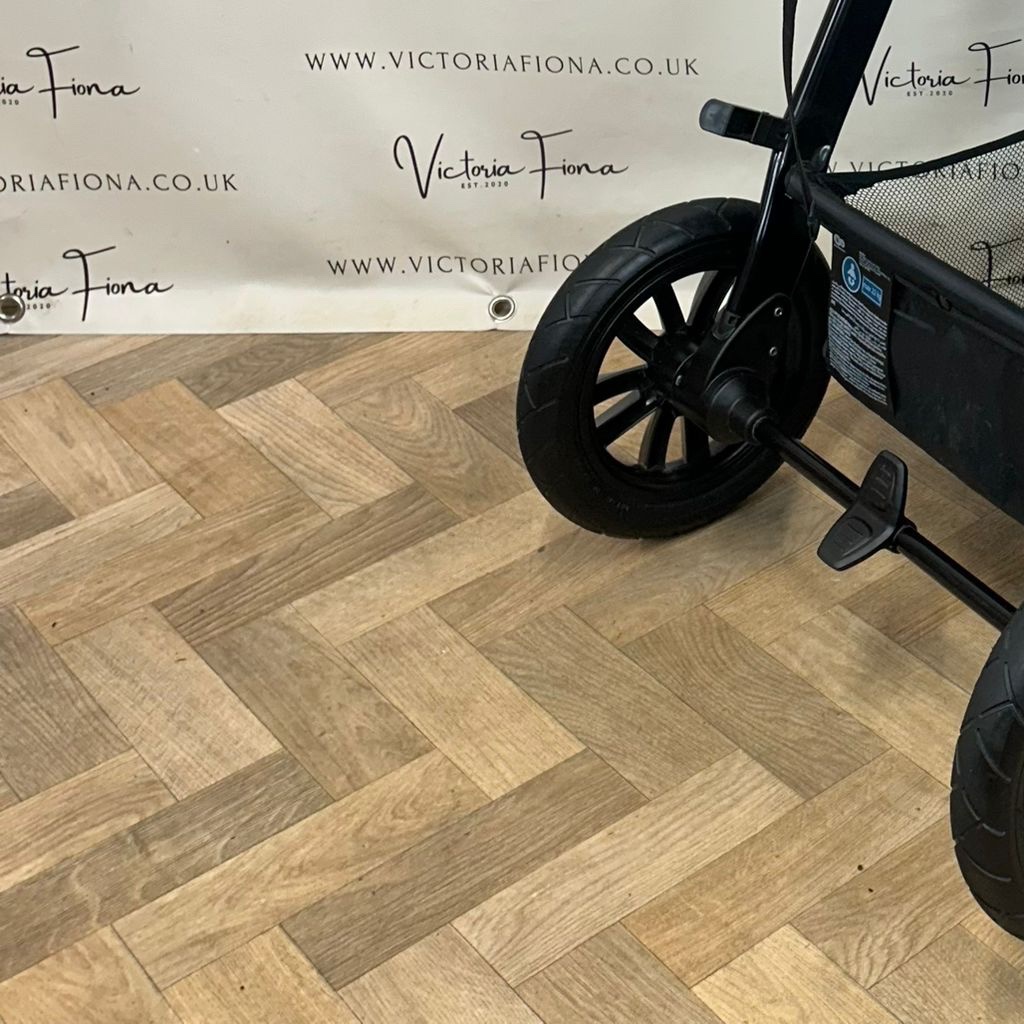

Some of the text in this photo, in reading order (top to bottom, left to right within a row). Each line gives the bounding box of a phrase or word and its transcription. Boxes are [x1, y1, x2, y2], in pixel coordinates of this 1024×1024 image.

[26, 46, 140, 119] Fiona
[305, 51, 699, 77] WWW.VICTORIAFIONA.CO.UK
[393, 129, 628, 200] Victoria Fiona
[62, 247, 174, 322] Fiona
